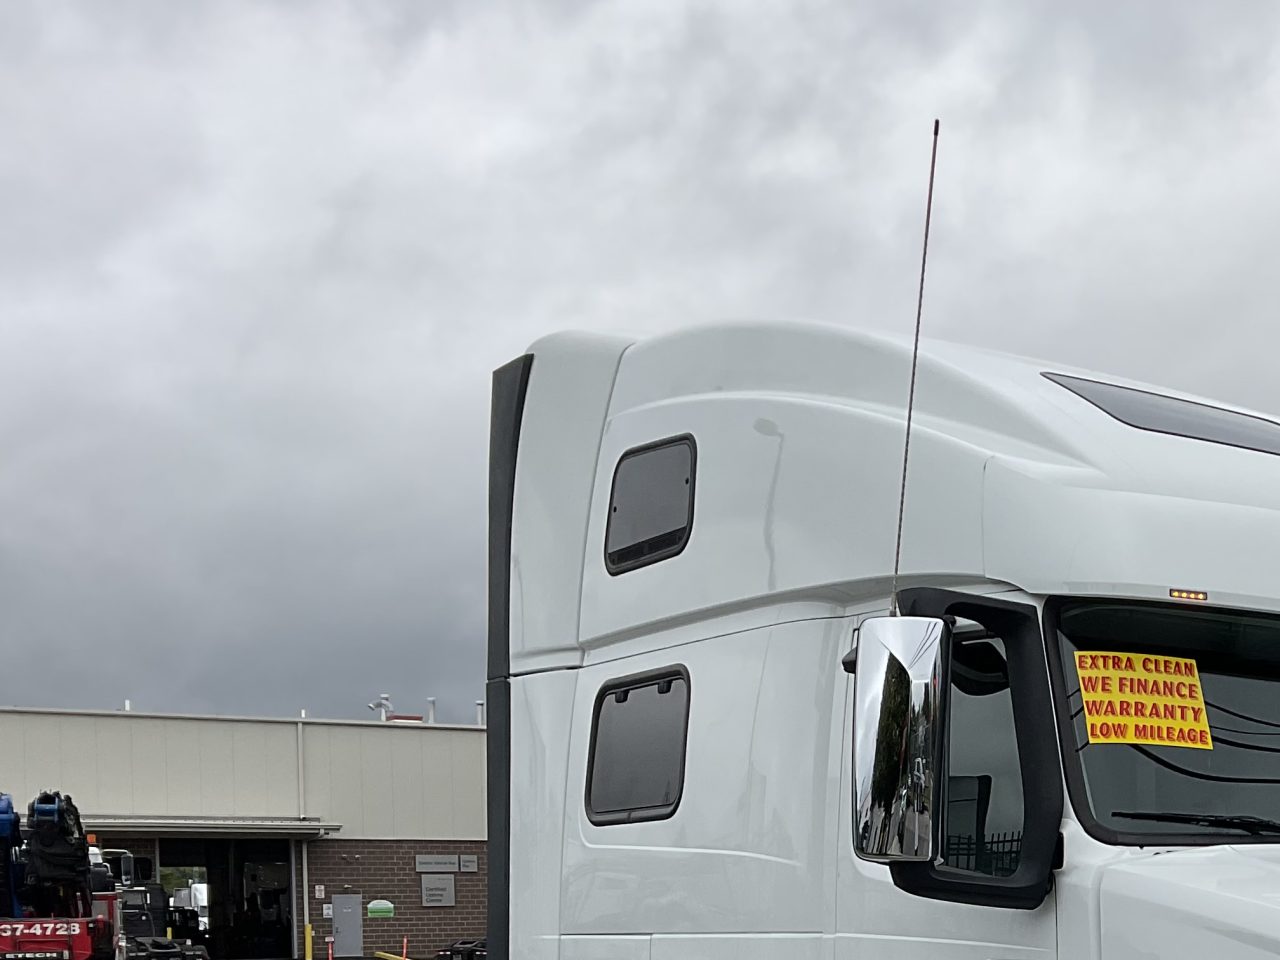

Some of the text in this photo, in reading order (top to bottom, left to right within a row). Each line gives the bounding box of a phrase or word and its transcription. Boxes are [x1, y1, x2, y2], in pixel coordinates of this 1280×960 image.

[1078, 655, 1196, 678] EXTRA CLEAN
[1081, 676, 1200, 700] WE FINANCE
[1085, 700, 1203, 723] WARRANTY
[1090, 722, 1209, 745] LOW MILEAGE
